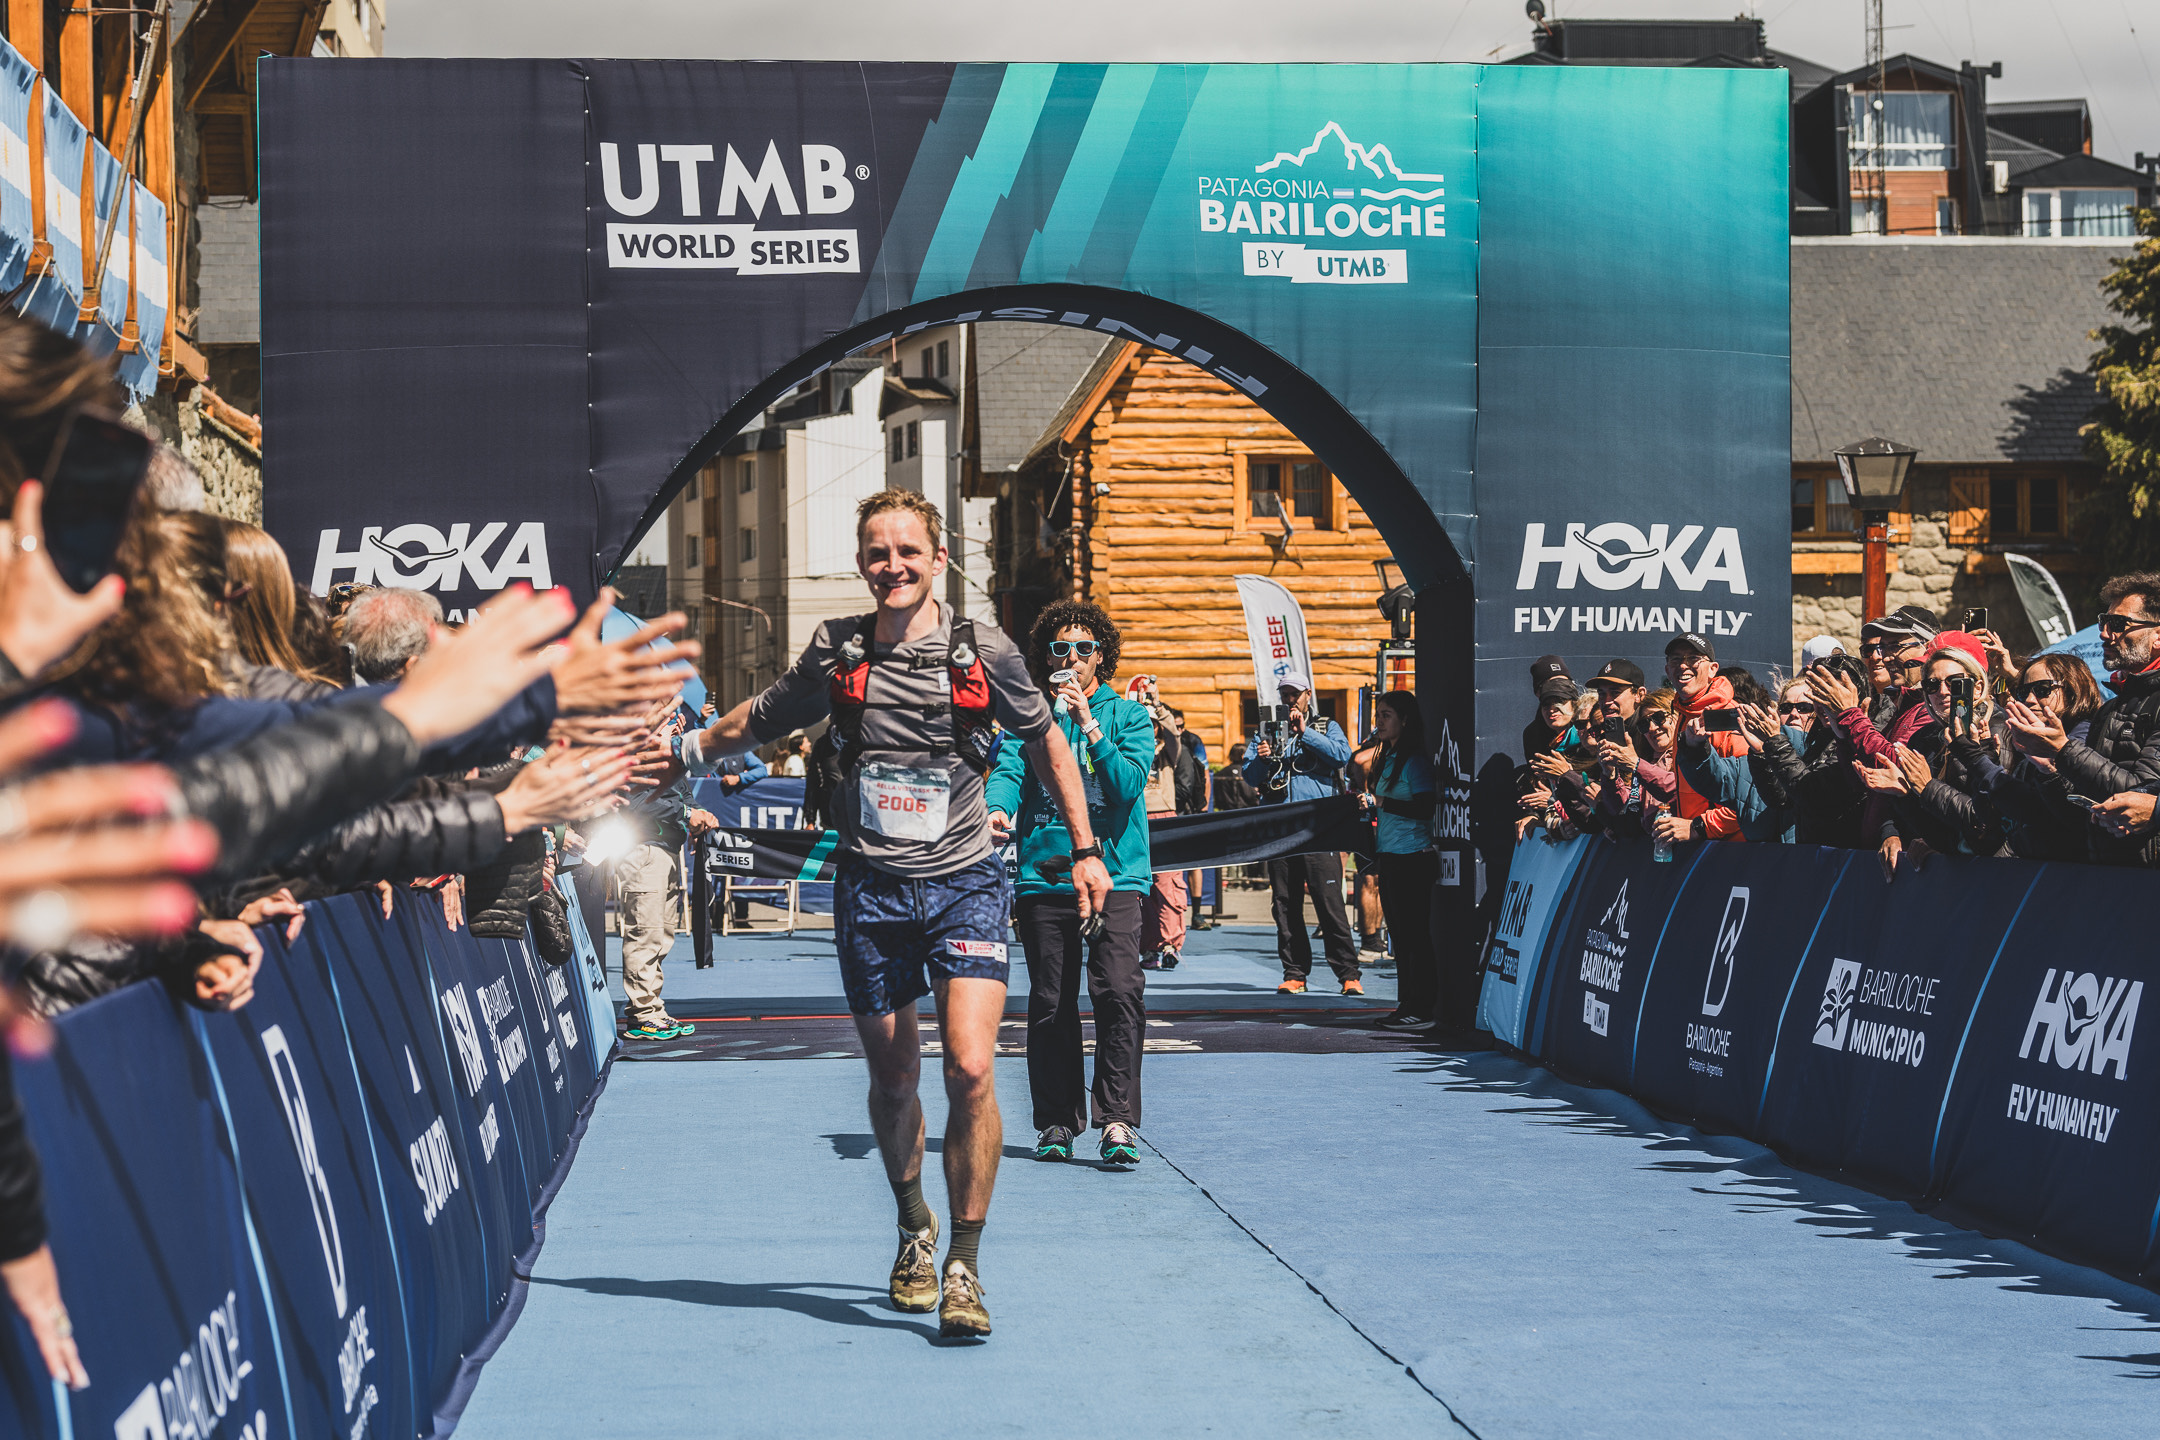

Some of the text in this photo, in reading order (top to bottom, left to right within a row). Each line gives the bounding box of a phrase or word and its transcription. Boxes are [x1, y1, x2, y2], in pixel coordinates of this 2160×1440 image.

[1198, 176, 1330, 199] PATAGONIA
[1200, 199, 1446, 237] BARILOCHE
[618, 233, 850, 266] WORLD SERIES
[1257, 250, 1387, 278] BY UTMB
[310, 522, 553, 598] HOKA
[1516, 522, 1750, 595] HOKA
[1266, 616, 1288, 658] BEEF
[1514, 606, 1751, 636] FLY HUMAN FLY
[877, 794, 927, 813] 2006
[1433, 803, 1471, 841] ILOCHE
[715, 853, 750, 866] SERIES
[1580, 949, 1624, 993] BARILOCHE
[1859, 969, 1940, 1016] BARILOCHE
[1685, 1022, 1732, 1058] BARILOCHE
[1848, 1018, 1925, 1068] MUNICIPIO
[2018, 967, 2144, 1081] HOKA
[2006, 1083, 2119, 1144] FLY HUMAN FLY
